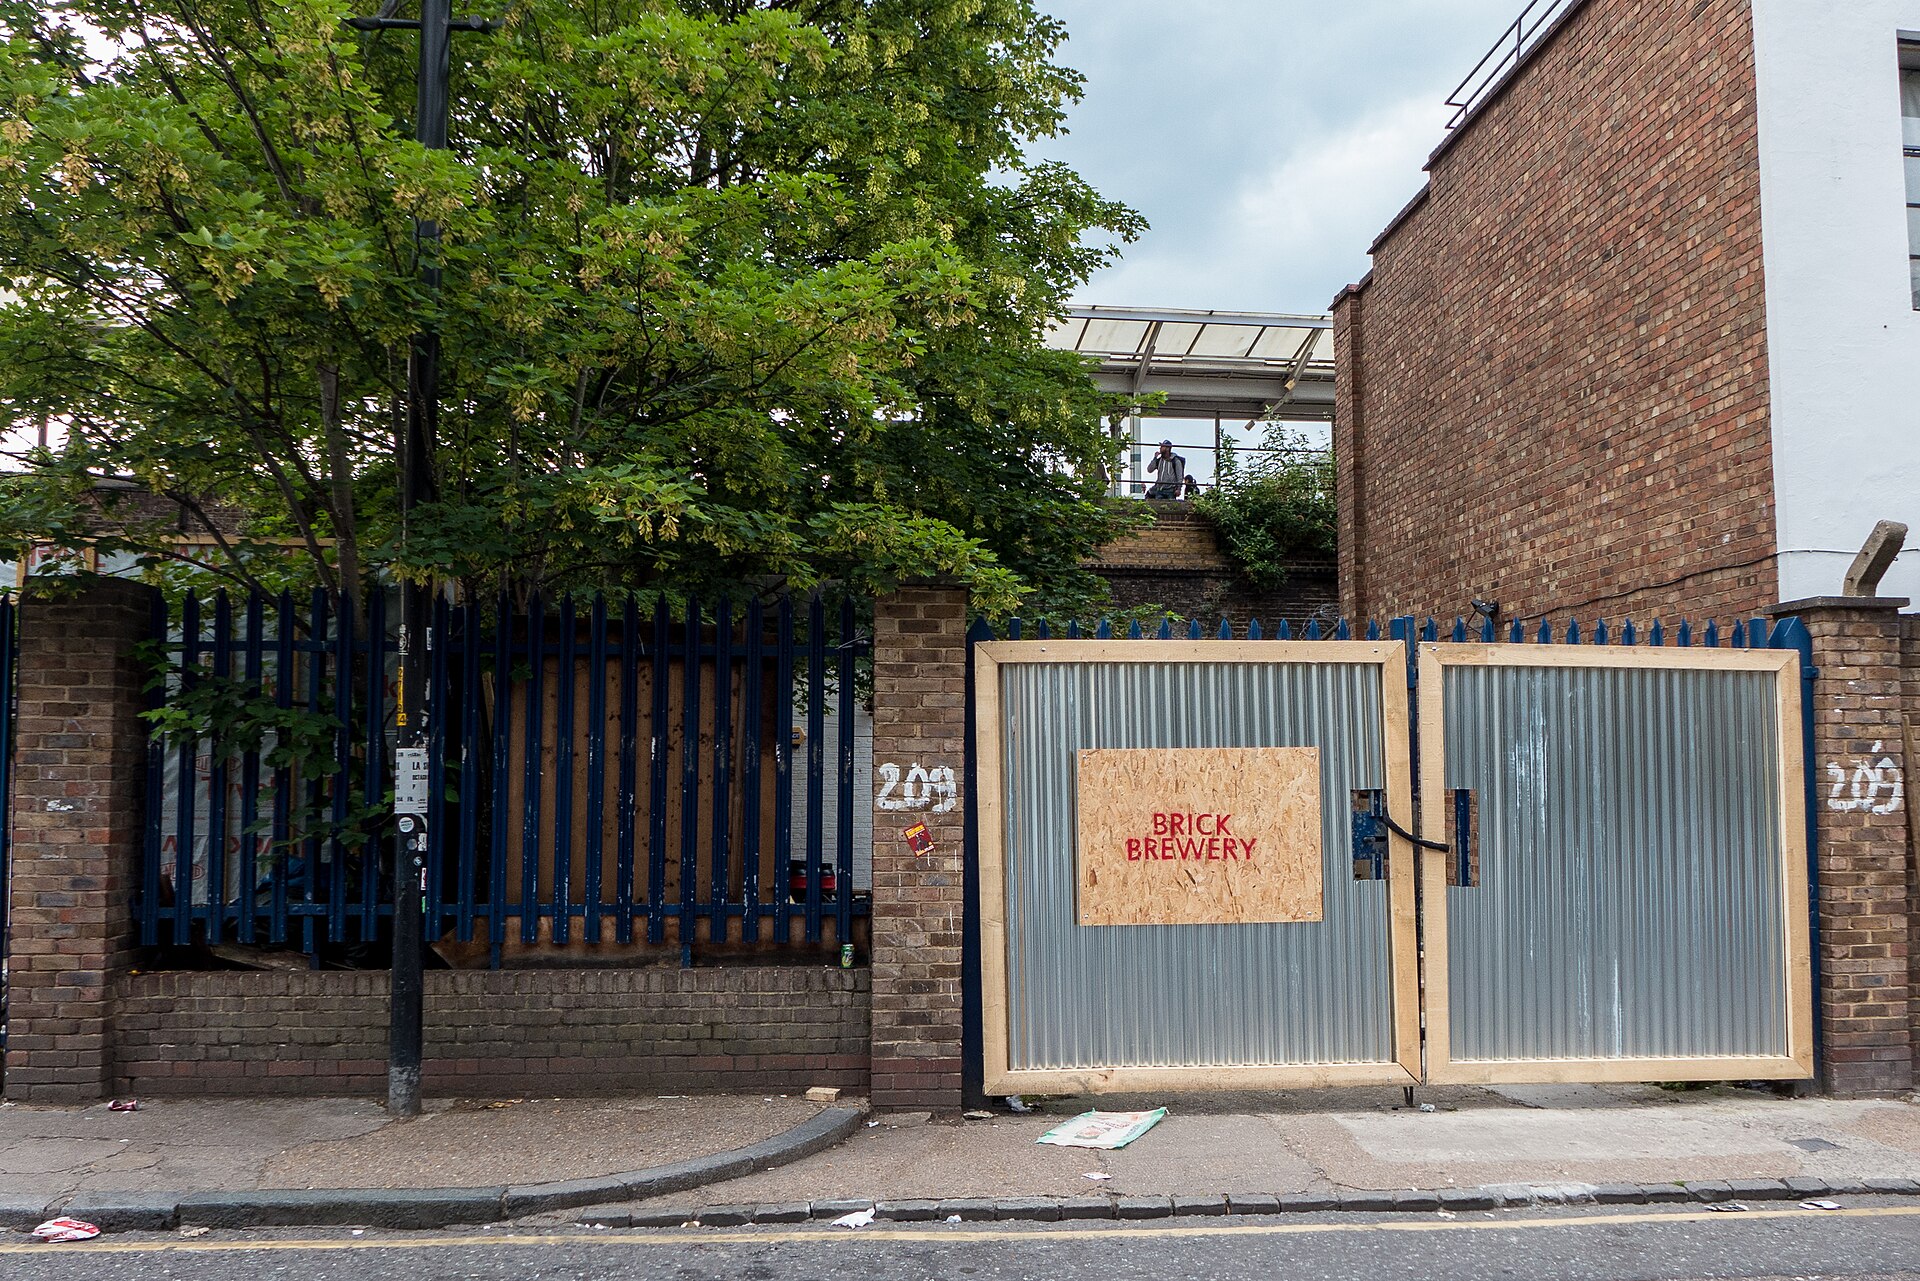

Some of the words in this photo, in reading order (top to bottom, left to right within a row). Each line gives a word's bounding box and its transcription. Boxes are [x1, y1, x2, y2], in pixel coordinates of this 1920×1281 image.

[876, 762, 957, 813] 209
[1826, 757, 1904, 815] 209
[1153, 812, 1232, 837] BRICK
[1125, 837, 1258, 862] BREWERY
